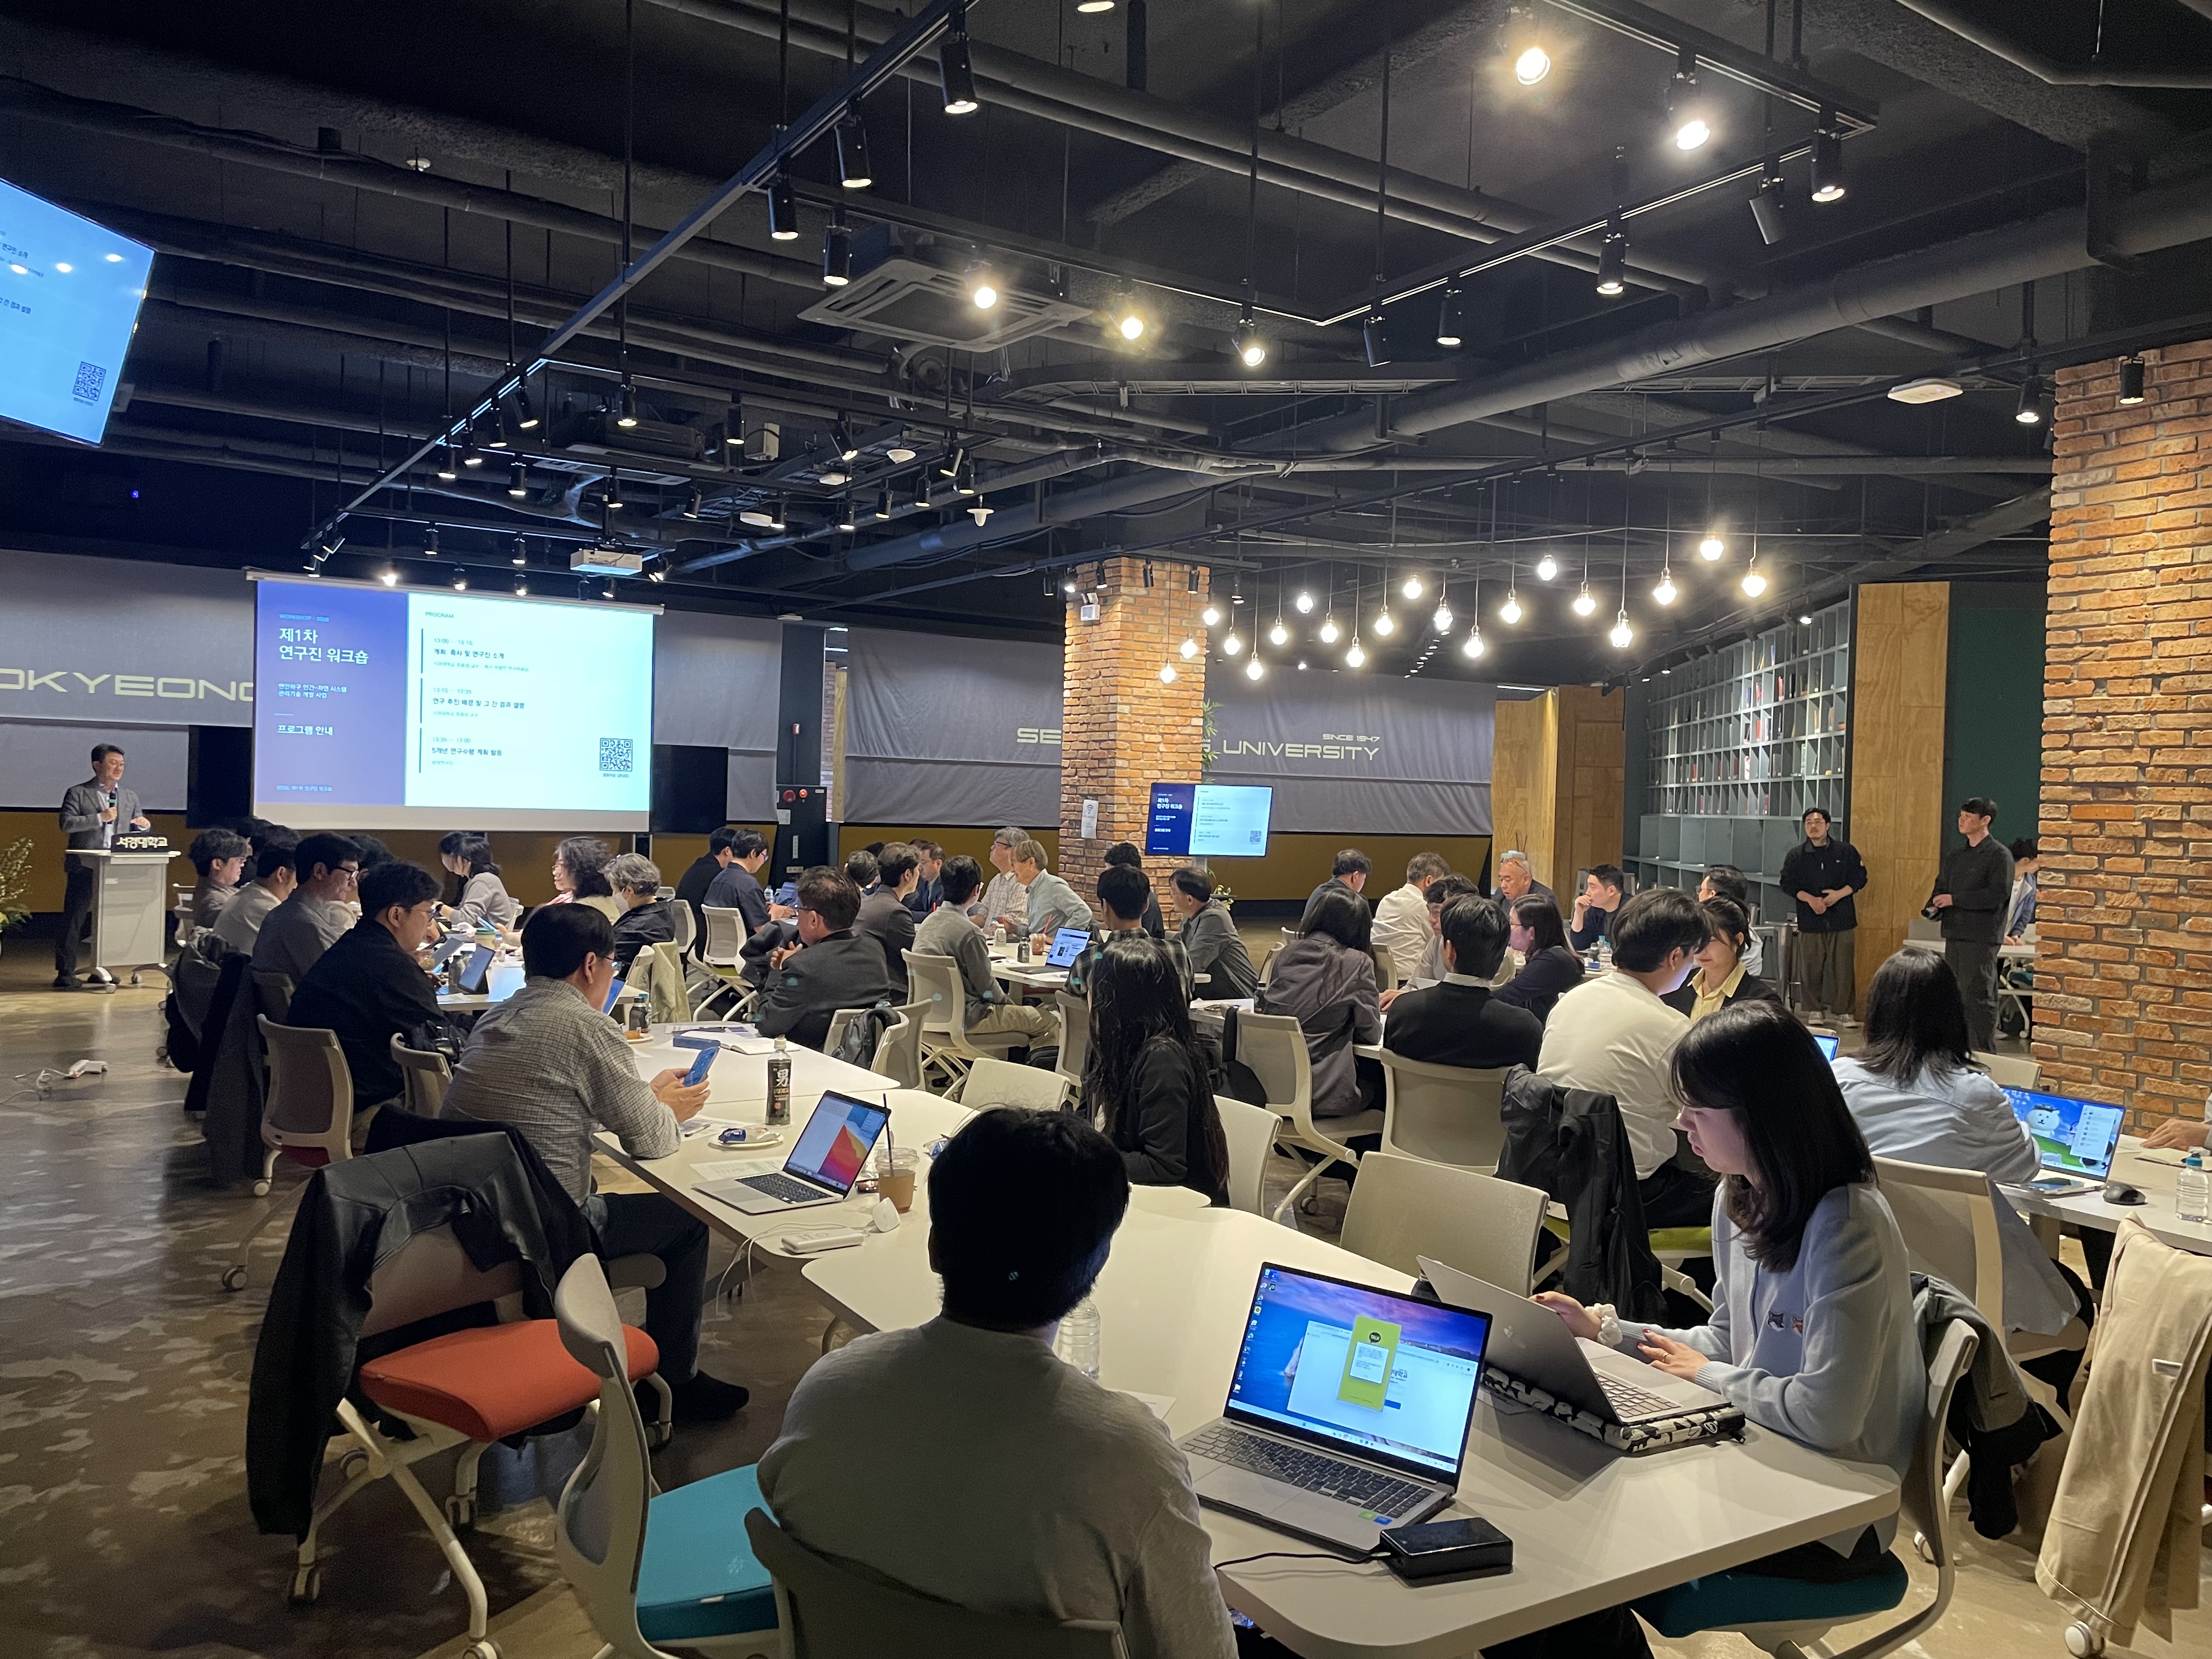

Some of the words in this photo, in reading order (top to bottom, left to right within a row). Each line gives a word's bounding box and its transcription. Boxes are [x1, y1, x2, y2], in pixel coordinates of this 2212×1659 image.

[279, 628, 318, 644] 제1차
[279, 645, 321, 662] 연구진
[327, 648, 369, 664] 워크숍
[278, 725, 313, 735] 프로그램
[315, 726, 334, 736] 안내
[1322, 733, 1354, 741] SINCE
[1223, 740, 1380, 761] UNIVERSITY
[116, 836, 168, 849] 서경대학교
[776, 1069, 789, 1087] 男
